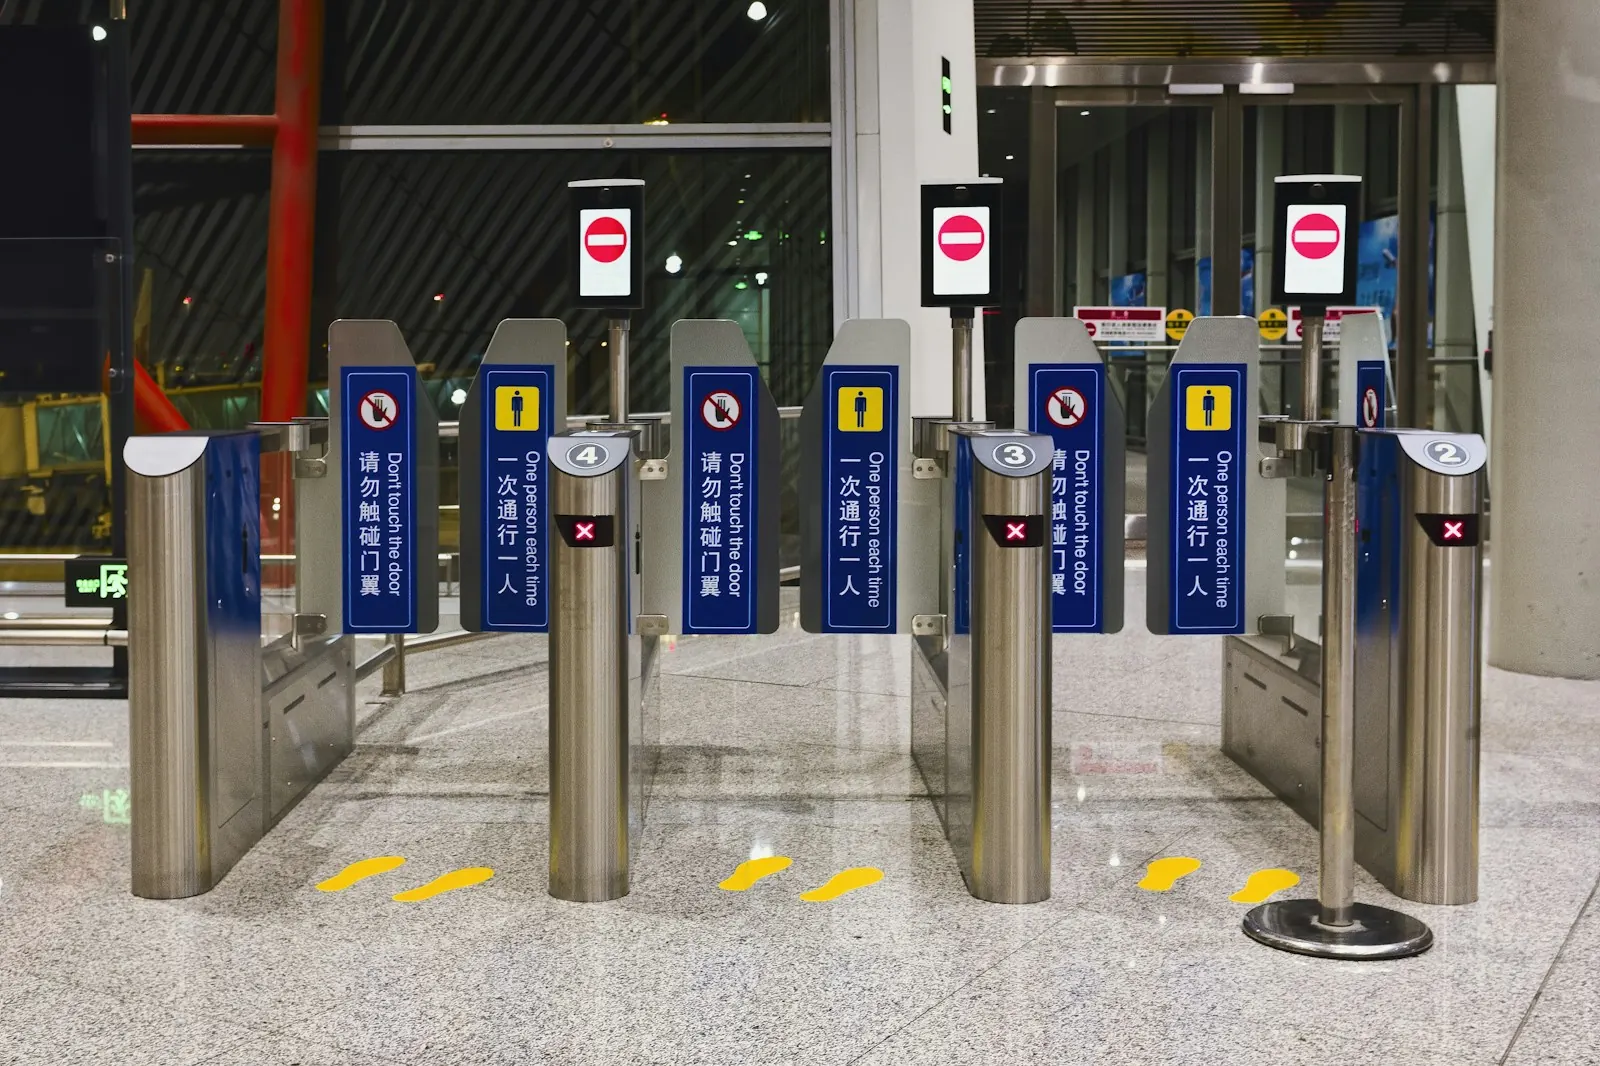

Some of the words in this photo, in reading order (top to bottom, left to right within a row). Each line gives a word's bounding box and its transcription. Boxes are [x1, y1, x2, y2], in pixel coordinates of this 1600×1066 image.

[526, 451, 540, 481] One
[576, 447, 598, 464] 4
[869, 452, 884, 482] One
[1003, 446, 1027, 464] 3
[1217, 451, 1232, 481] One
[1435, 443, 1461, 463] 2
[359, 451, 381, 596] 请勿触碰门翼
[388, 492, 402, 532] touch
[497, 457, 519, 594] 一次通行一人
[523, 485, 537, 533] person
[700, 452, 722, 597] 请勿触碰门翼
[729, 493, 743, 533] touch
[866, 486, 881, 535] person
[1075, 491, 1089, 531] touch
[1214, 486, 1228, 534] person
[839, 458, 861, 596] 一次通行一人
[1187, 457, 1209, 597] 一次通行一人
[388, 536, 402, 559] the
[526, 538, 540, 572] each
[729, 537, 743, 560] the
[869, 539, 882, 573] each
[1075, 535, 1089, 557] the
[1217, 539, 1230, 573] each
[388, 562, 402, 596] door
[526, 576, 540, 606] time
[729, 564, 743, 597] door
[868, 577, 882, 607] time
[1074, 561, 1088, 595] door
[1216, 577, 1230, 608] time
